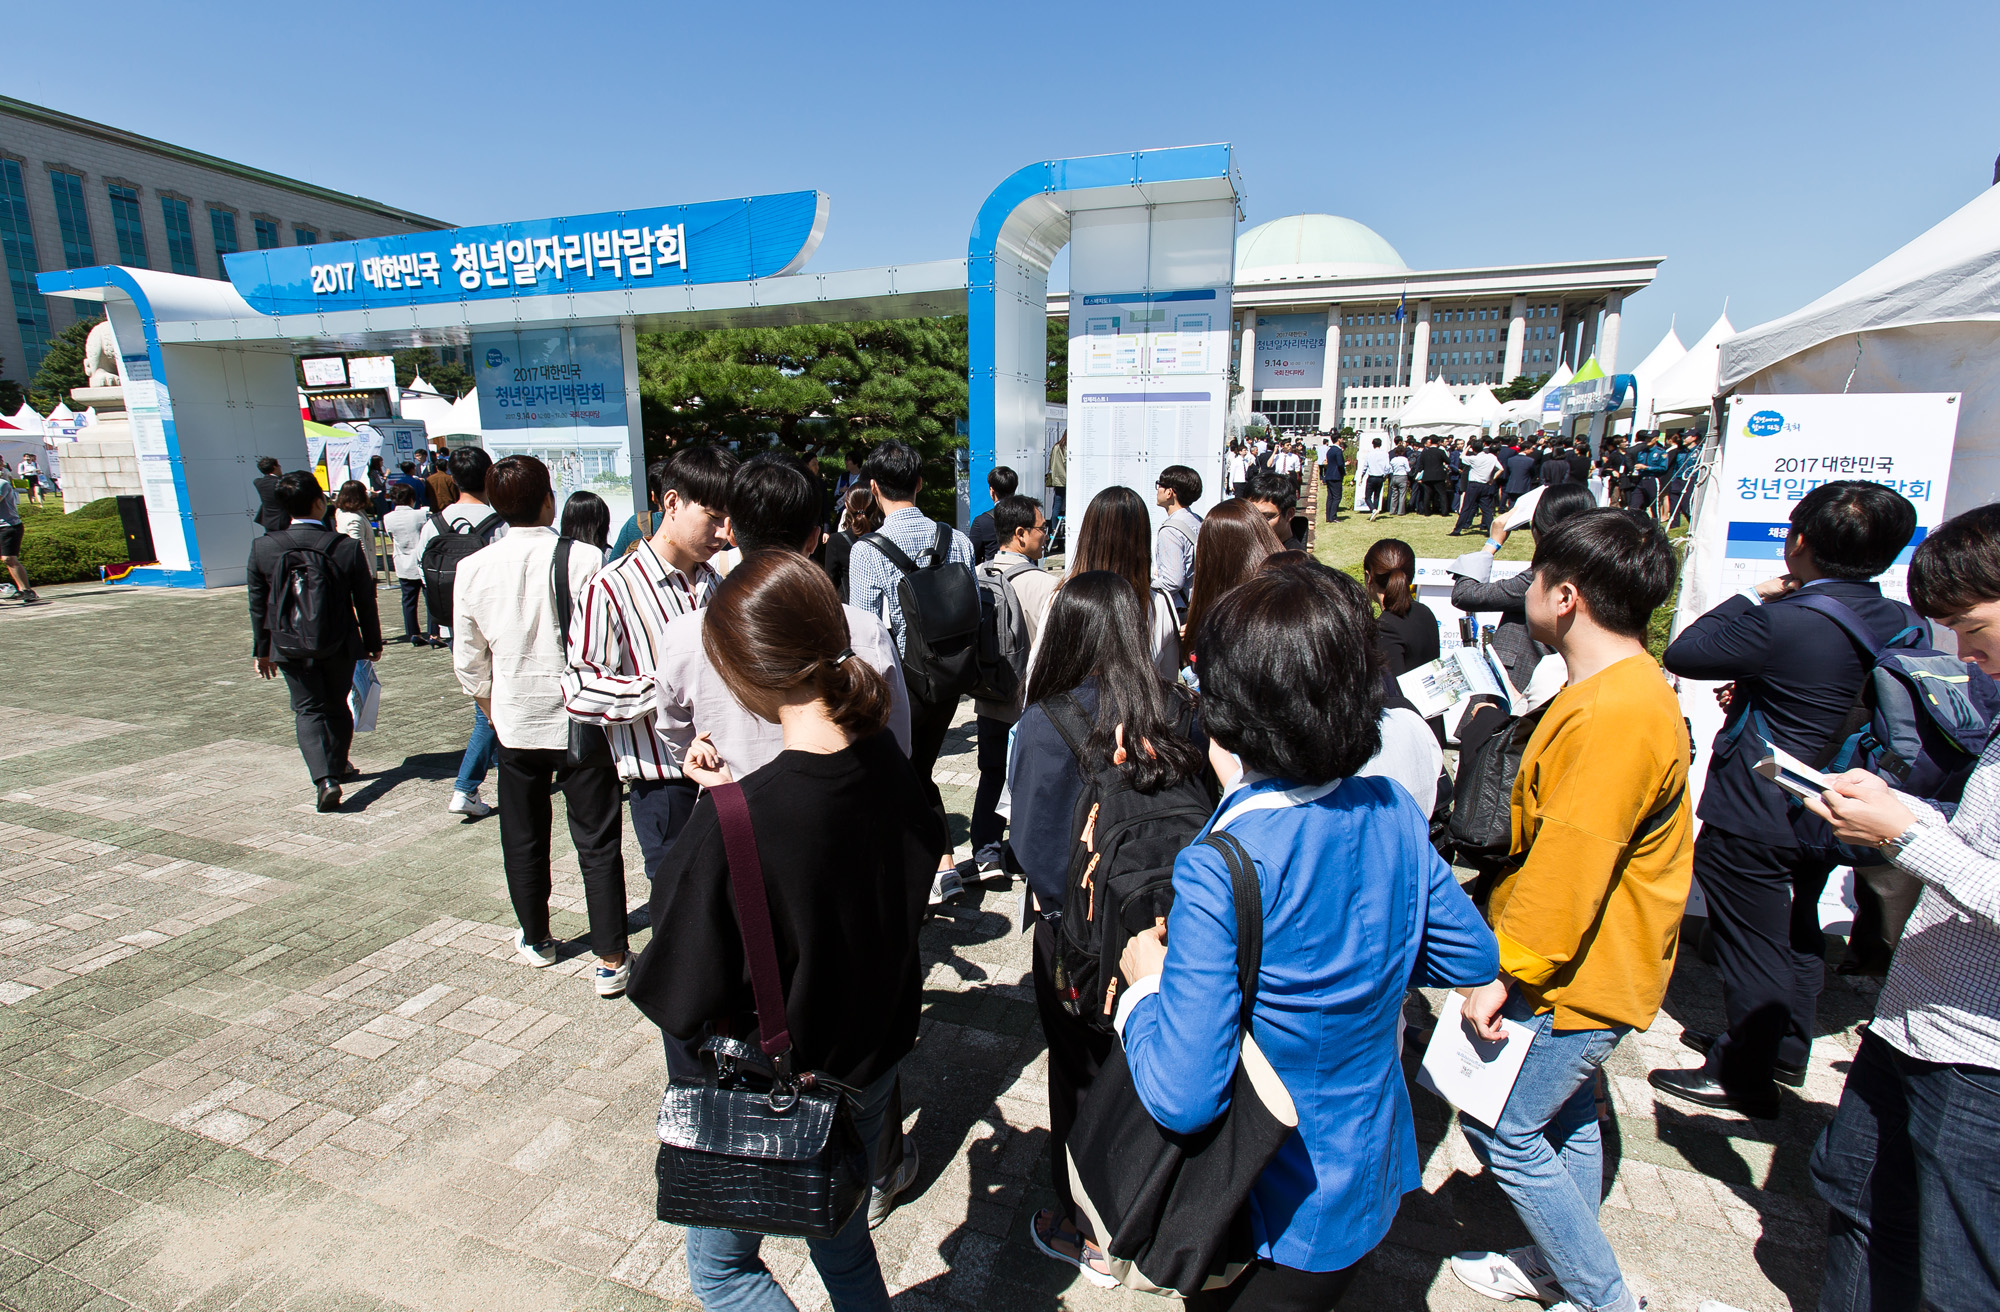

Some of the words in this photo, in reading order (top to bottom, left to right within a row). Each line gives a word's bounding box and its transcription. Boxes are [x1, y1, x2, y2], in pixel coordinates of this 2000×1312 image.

[311, 262, 356, 294] 2017
[362, 250, 441, 289] 대한민국
[451, 223, 688, 289] 청년일자리박람회
[1257, 338, 1325, 350] 청년일자리박람회
[1264, 359, 1281, 368] 9.14
[513, 367, 538, 382] 2017
[540, 363, 581, 380] 대한민국
[495, 382, 606, 408] 청년일자리박람회
[1774, 458, 1819, 473] 2017
[1821, 456, 1895, 474] 대한민국
[1734, 562, 1746, 570] NO
[1443, 631, 1460, 639] 2017
